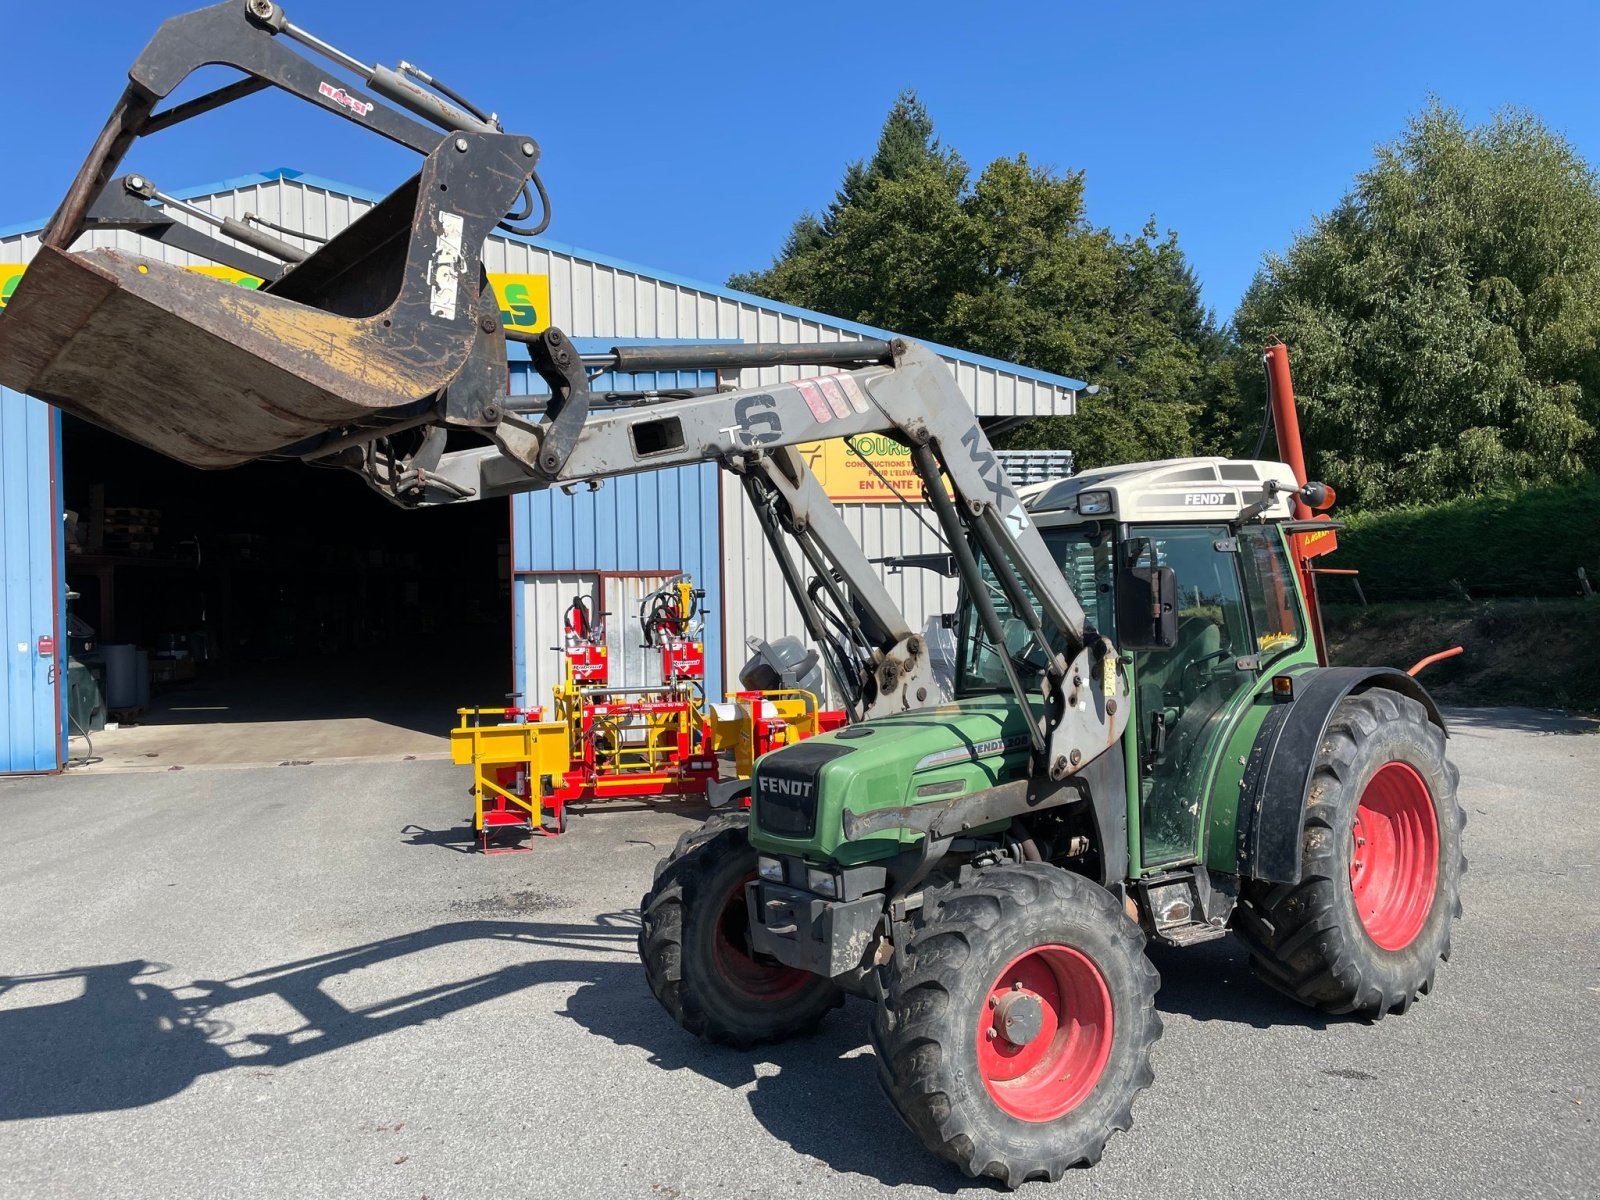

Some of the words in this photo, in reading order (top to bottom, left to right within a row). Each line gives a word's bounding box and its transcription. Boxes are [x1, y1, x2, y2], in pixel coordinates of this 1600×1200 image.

[845, 460, 905, 468] CONSRUCTIONS
[859, 480, 875, 490] EN
[1184, 492, 1226, 505] FENDT
[972, 739, 1005, 754] FENDT
[758, 775, 813, 798] FENDT
